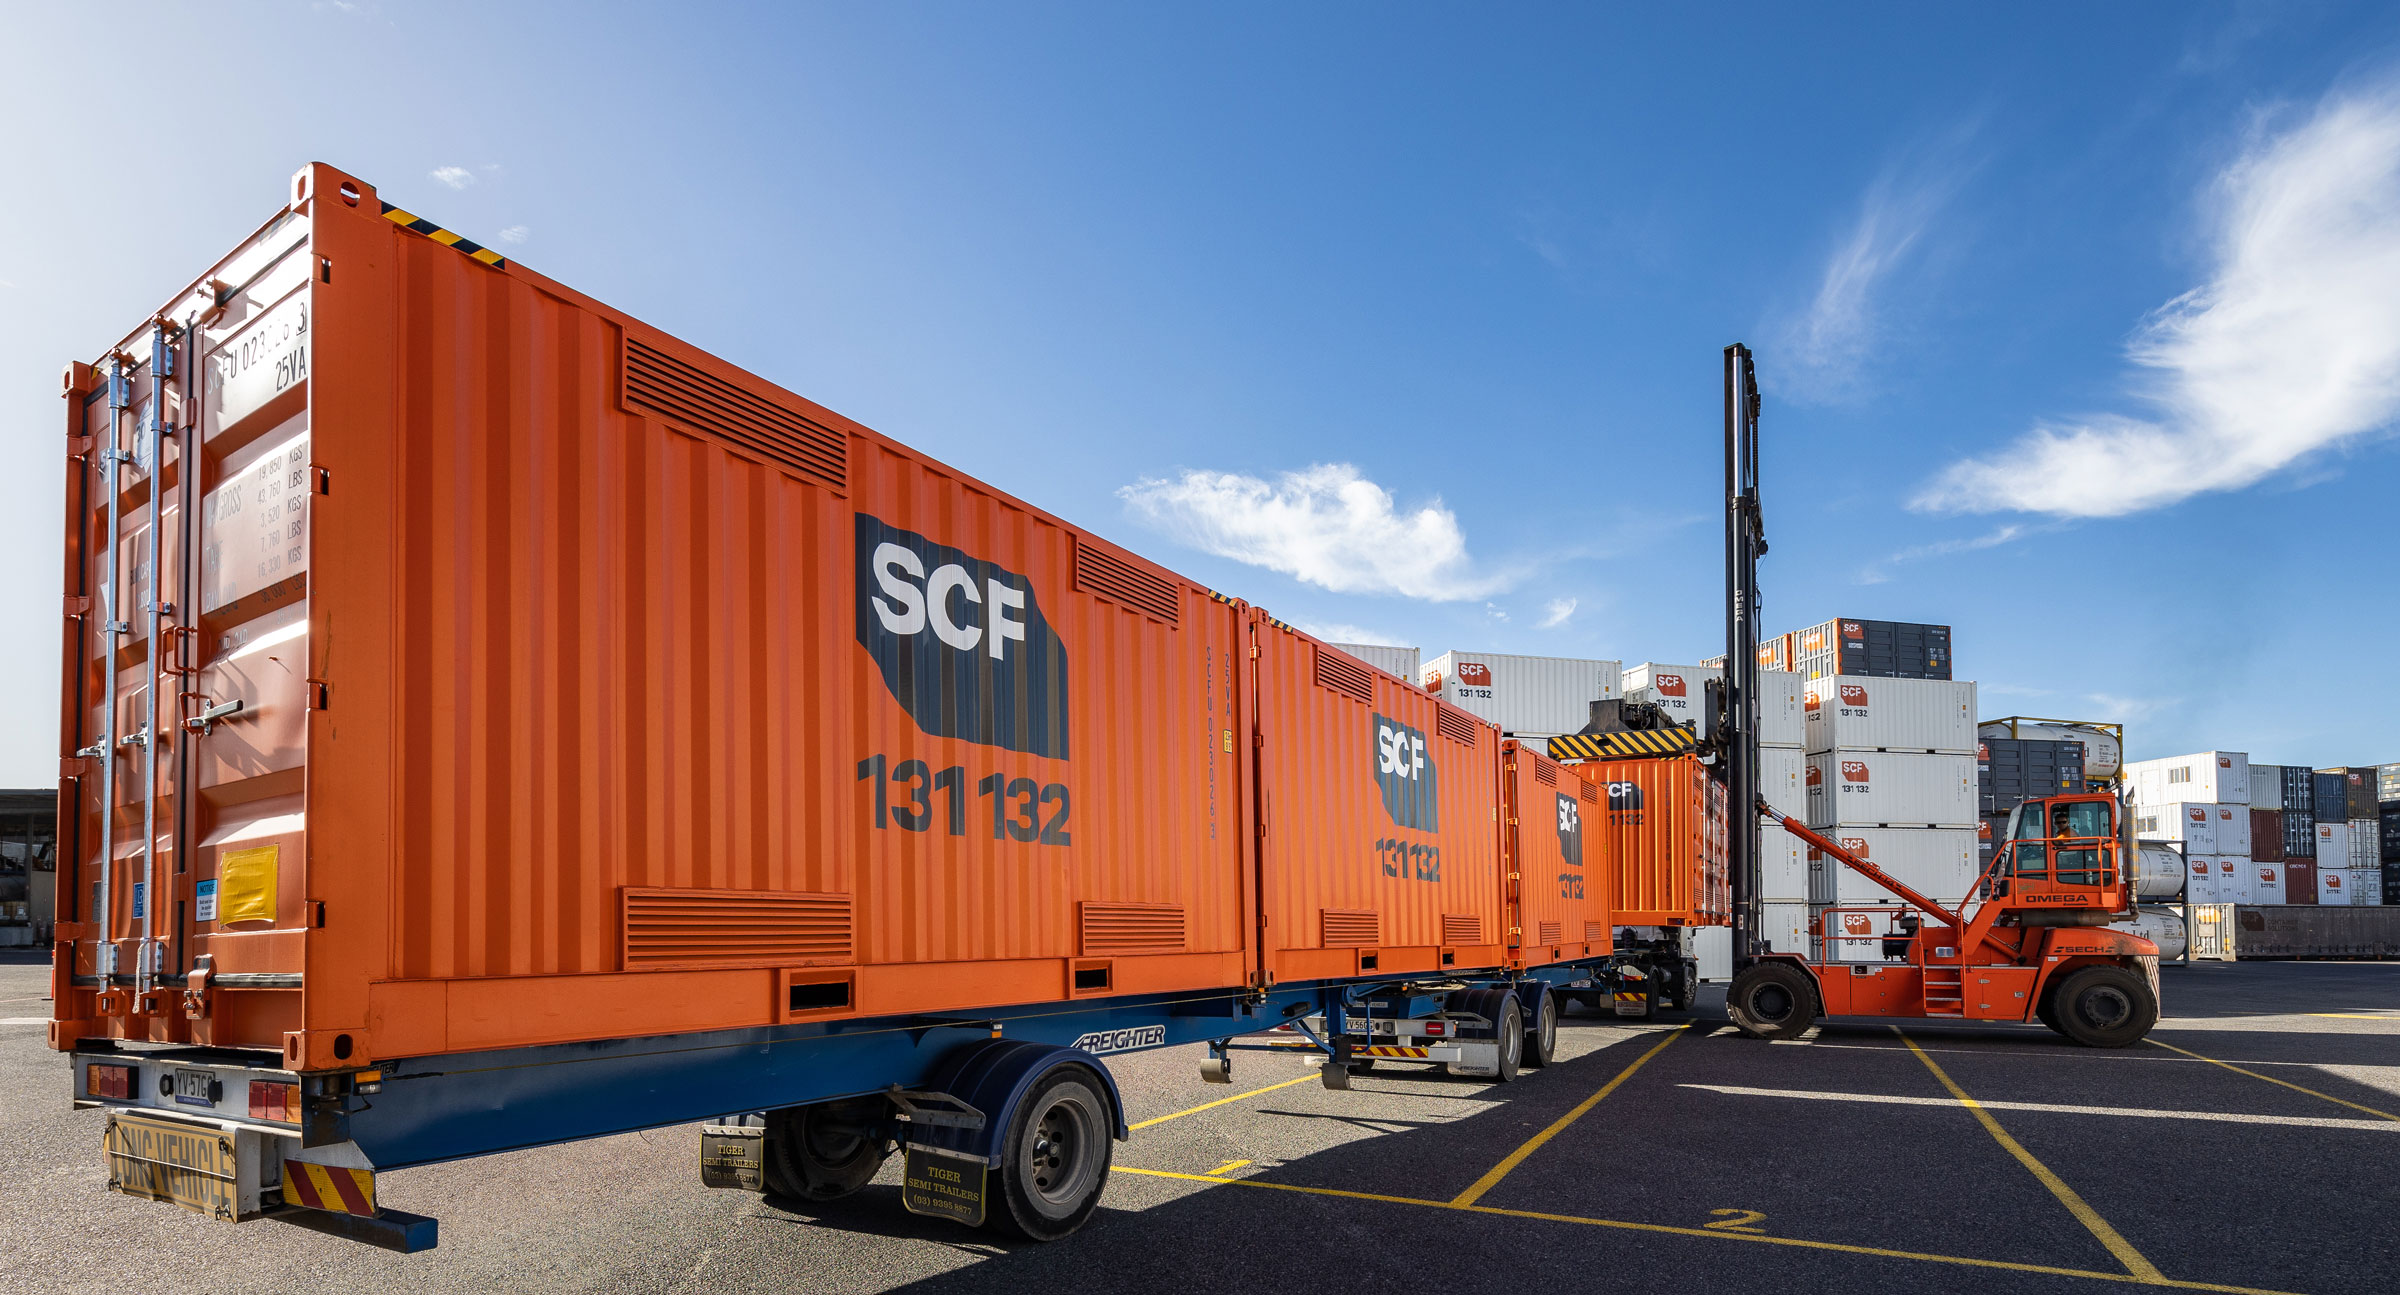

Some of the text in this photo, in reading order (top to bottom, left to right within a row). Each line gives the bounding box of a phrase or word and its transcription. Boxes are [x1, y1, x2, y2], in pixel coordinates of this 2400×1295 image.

[275, 346, 307, 392] 25VA
[288, 444, 303, 465] KGS
[288, 469, 303, 490] LBS
[287, 494, 302, 515] KGS
[287, 519, 302, 540] LBS
[287, 545, 302, 566] KGS
[871, 542, 1025, 662] SCF
[1843, 623, 1860, 632] SCF
[1460, 664, 1484, 676] SCF
[1658, 676, 1681, 687] SCF
[1459, 688, 1492, 699] 131 132
[1841, 687, 1862, 697] SCF
[1656, 699, 1687, 709] 131 132
[1840, 708, 1868, 718] 131 132
[1379, 725, 1424, 781] SCF
[1843, 763, 1863, 773] SCF
[1608, 782, 1632, 798] CF
[1842, 784, 1869, 793] 131 132
[857, 753, 1072, 848] 131 132
[1559, 798, 1578, 833] SCF
[2190, 808, 2203, 816] SCF
[1620, 814, 1644, 826] 132
[1843, 839, 1863, 850] SCF
[1375, 837, 1441, 883] 131 132
[2192, 861, 2204, 869] SCF
[199, 883, 215, 894] NOTICE
[2025, 894, 2089, 903] OMEGA
[1845, 915, 1866, 926] SCF
[1079, 1026, 1165, 1052] FREIGHTER
[717, 1144, 744, 1156] TIGER
[112, 1124, 232, 1209] LONG VEHICLE
[702, 1157, 759, 1169] SEMI TRAILERS
[927, 1166, 961, 1184] TIGER
[908, 1178, 980, 1202] SEMI TRAILERS
[913, 1194, 931, 1207] (03)
[1703, 1208, 1768, 1234] 2
